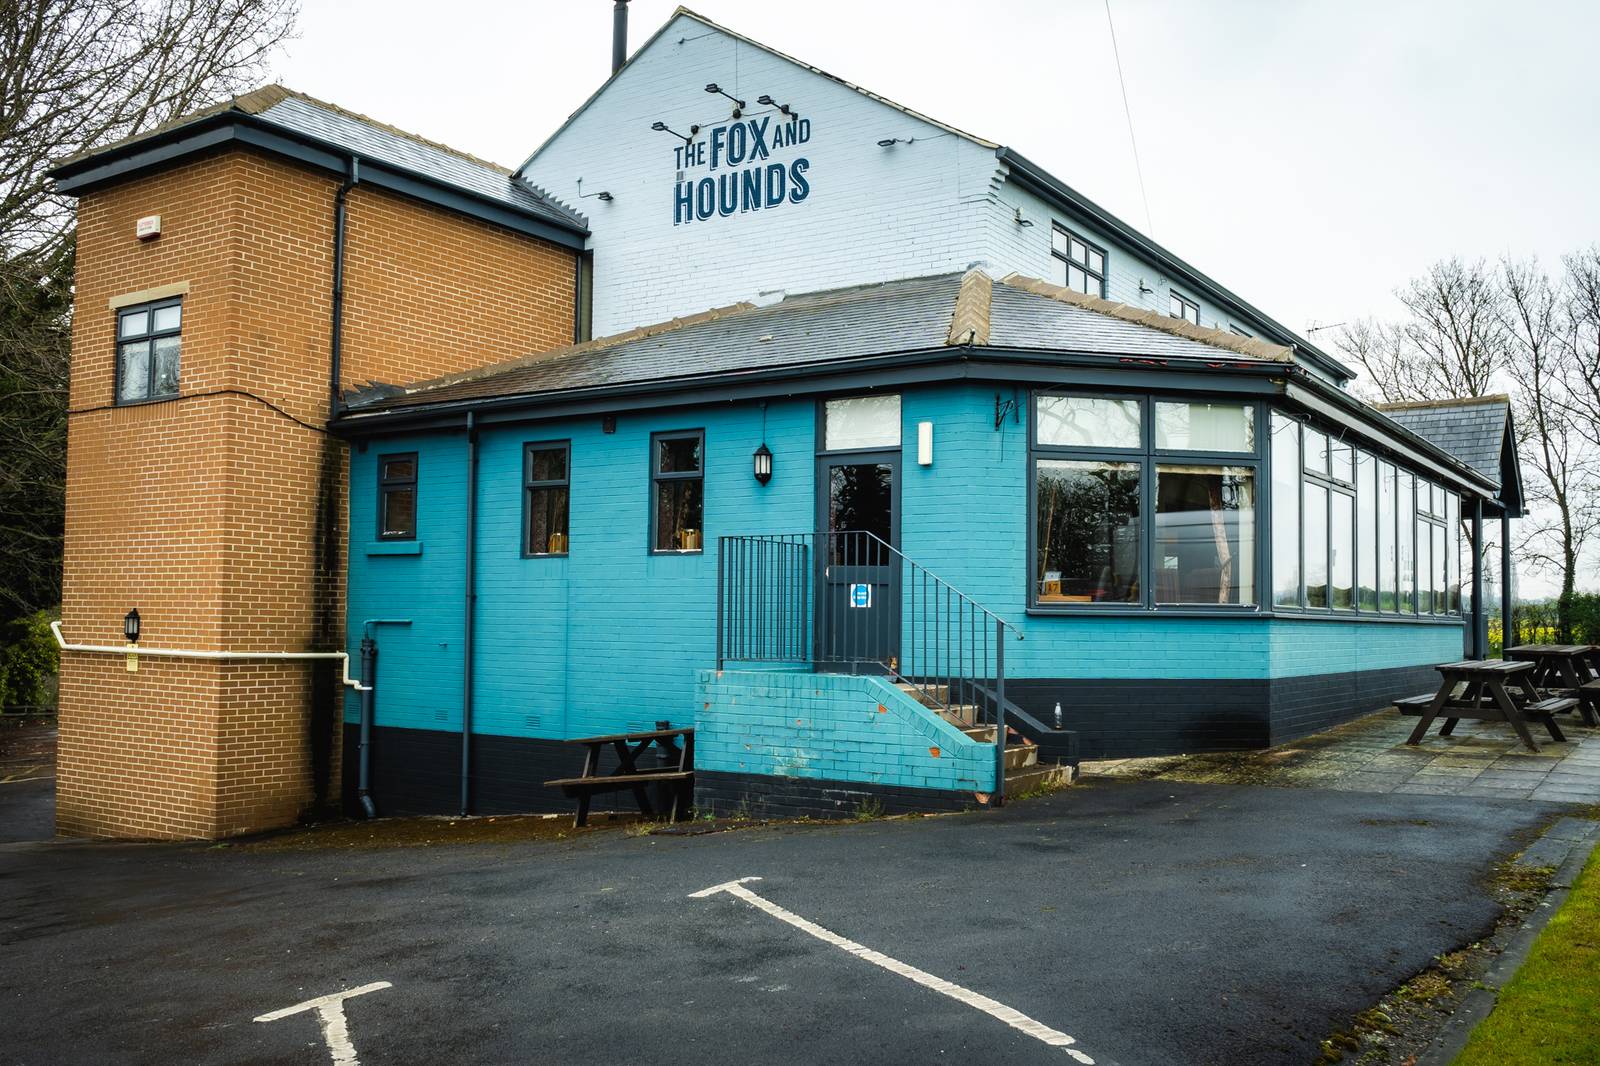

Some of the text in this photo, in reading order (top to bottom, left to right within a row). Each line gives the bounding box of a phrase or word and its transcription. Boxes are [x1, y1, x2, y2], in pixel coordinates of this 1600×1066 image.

[673, 116, 811, 171] THE FOX AND
[673, 157, 810, 226] HOUNDS
